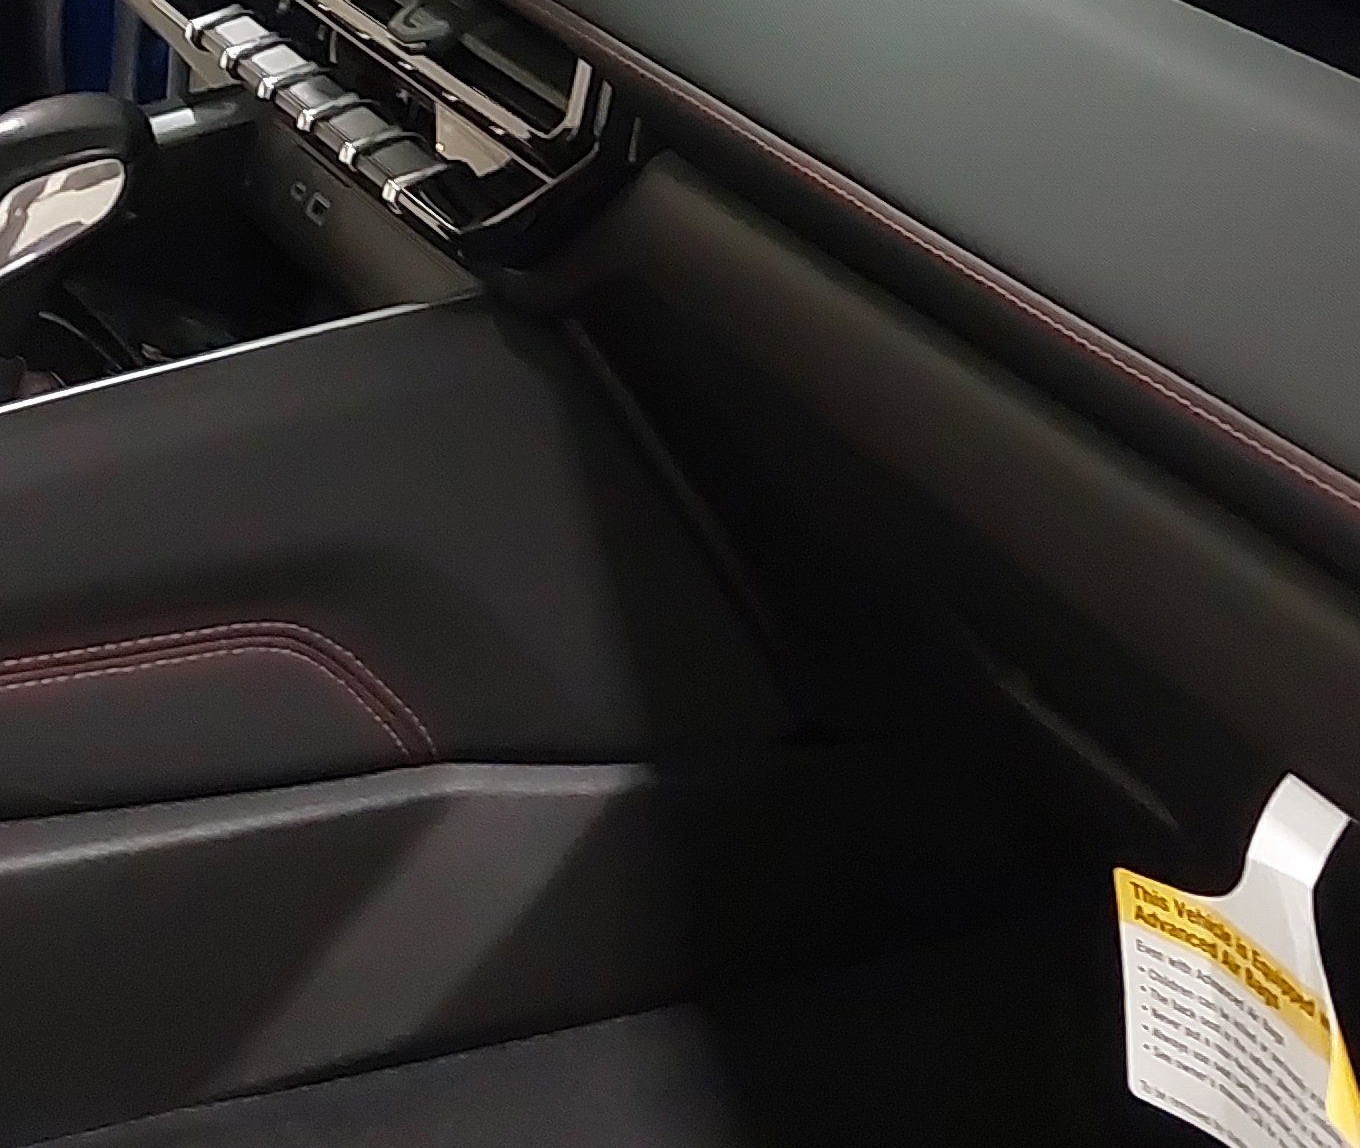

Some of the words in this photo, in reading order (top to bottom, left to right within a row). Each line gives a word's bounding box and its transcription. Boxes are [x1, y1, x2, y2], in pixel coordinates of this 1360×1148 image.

[1128, 880, 1170, 913] This
[1173, 898, 1232, 947] Vehicle
[1134, 904, 1218, 960] Advanced
